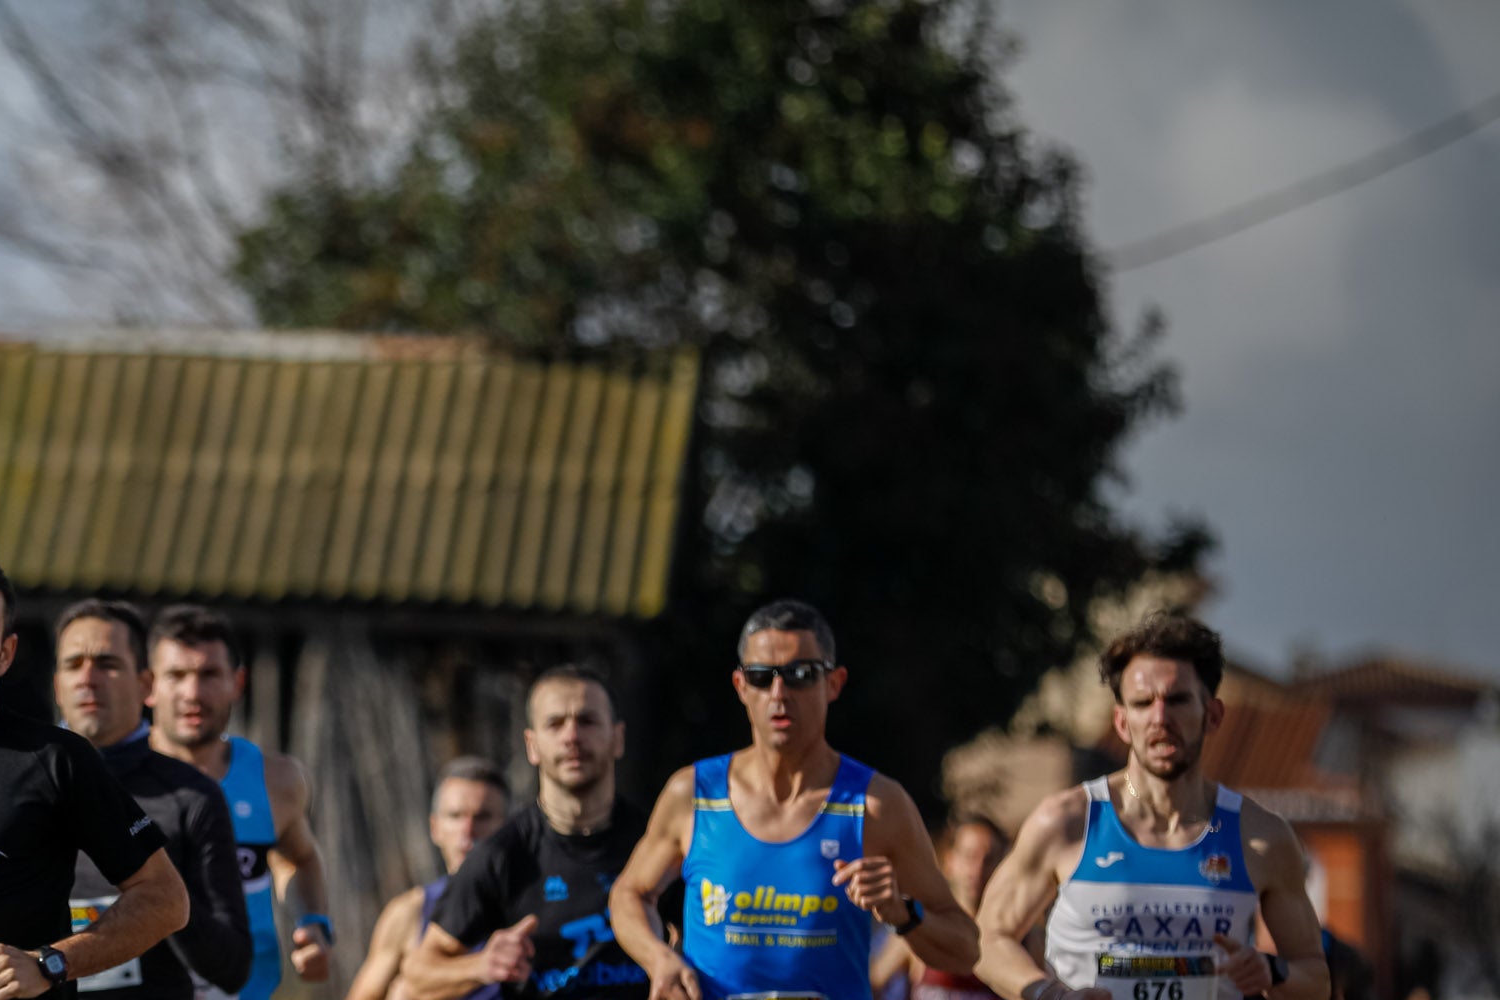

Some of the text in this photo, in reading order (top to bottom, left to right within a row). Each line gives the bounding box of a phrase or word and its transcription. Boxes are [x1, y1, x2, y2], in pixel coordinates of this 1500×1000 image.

[734, 885, 838, 918] olimpo
[730, 911, 797, 927] deportes
[725, 932, 759, 946] TRAIL
[777, 935, 837, 949] RUNNING
